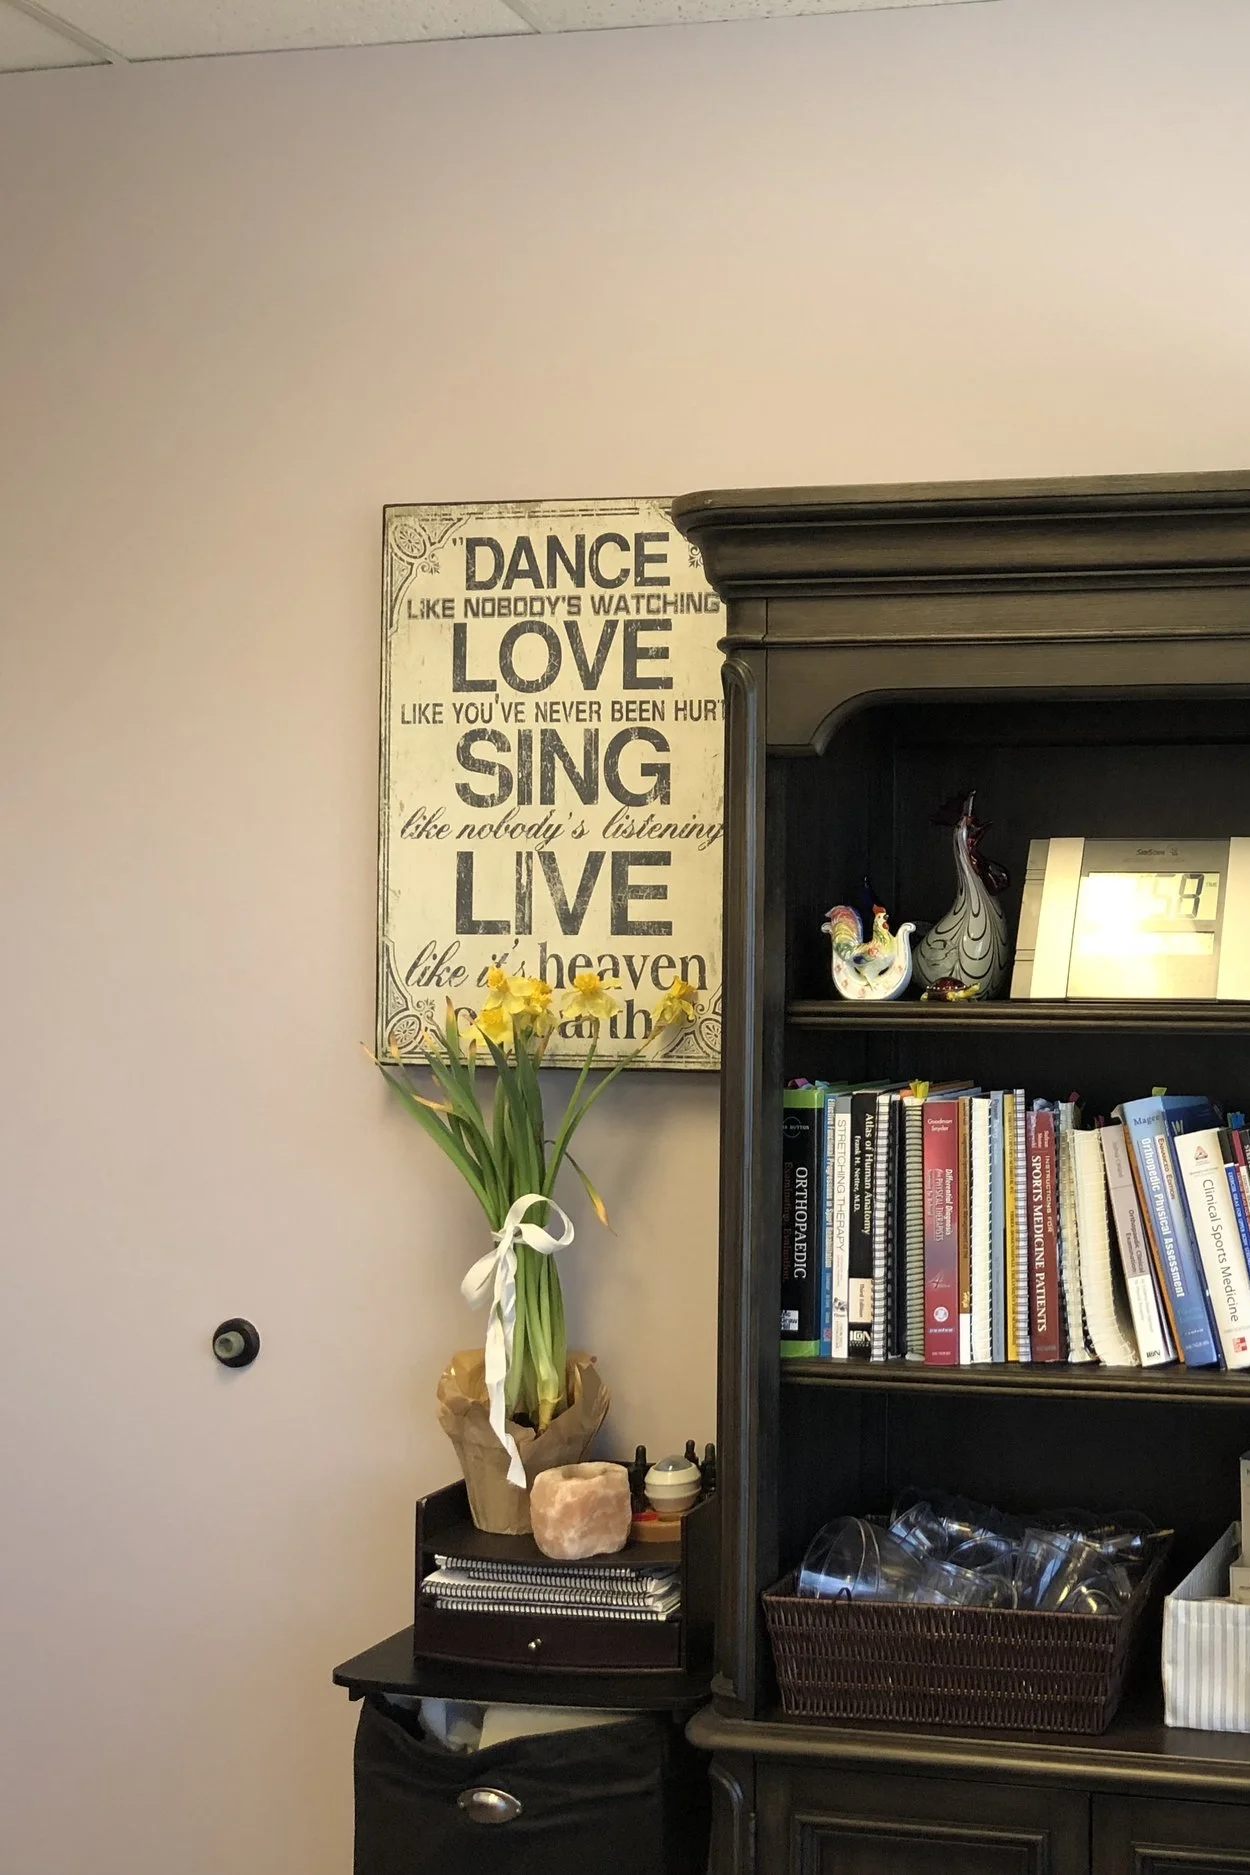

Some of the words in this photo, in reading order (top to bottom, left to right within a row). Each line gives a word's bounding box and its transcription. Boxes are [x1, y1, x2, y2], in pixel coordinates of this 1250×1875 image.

[407, 597, 455, 619] LIKE
[464, 595, 582, 618] NOBODY'S
[591, 592, 721, 617] WATCHING
[452, 618, 673, 693] LOVE
[401, 702, 443, 725] LIKE
[453, 694, 526, 724] YOU'VE
[535, 700, 602, 723] NEVER
[611, 700, 665, 722] BEEN
[455, 726, 671, 808] SING
[401, 806, 450, 840] like
[456, 805, 590, 851] nobody's
[602, 805, 724, 851] listening
[455, 850, 673, 936] LIVE
[404, 940, 468, 988] like
[539, 942, 708, 991] heaven
[865, 1113, 874, 1138] Atlas
[1132, 1113, 1161, 1126] Magee
[837, 1119, 847, 1194] STRETCHING
[854, 1157, 861, 1165] H.
[865, 1140, 875, 1152] of
[852, 1168, 861, 1193] Netter,
[864, 1153, 874, 1189] Human
[945, 1168, 954, 1204] Differential
[1031, 1155, 1043, 1201] SPORTS
[794, 1166, 808, 1278] ORTHOPAEDIC
[861, 1191, 873, 1236] Anatomy
[943, 1204, 954, 1235] Diagnosis
[1142, 1137, 1160, 1192] Orthopedic
[1153, 1193, 1171, 1235] Physical
[1164, 1238, 1185, 1298] Assessment
[1203, 1179, 1222, 1222] Clinical
[836, 1196, 846, 1253] THERAPY
[1033, 1204, 1046, 1270] MEDICINE
[1128, 1208, 1140, 1247] Orthopaedic
[1136, 1248, 1145, 1273] Clinical
[1211, 1224, 1227, 1264] Sports
[1125, 1232, 1137, 1273] Examination
[1035, 1271, 1048, 1333] PATIENTS
[1221, 1266, 1240, 1322] Medicine
